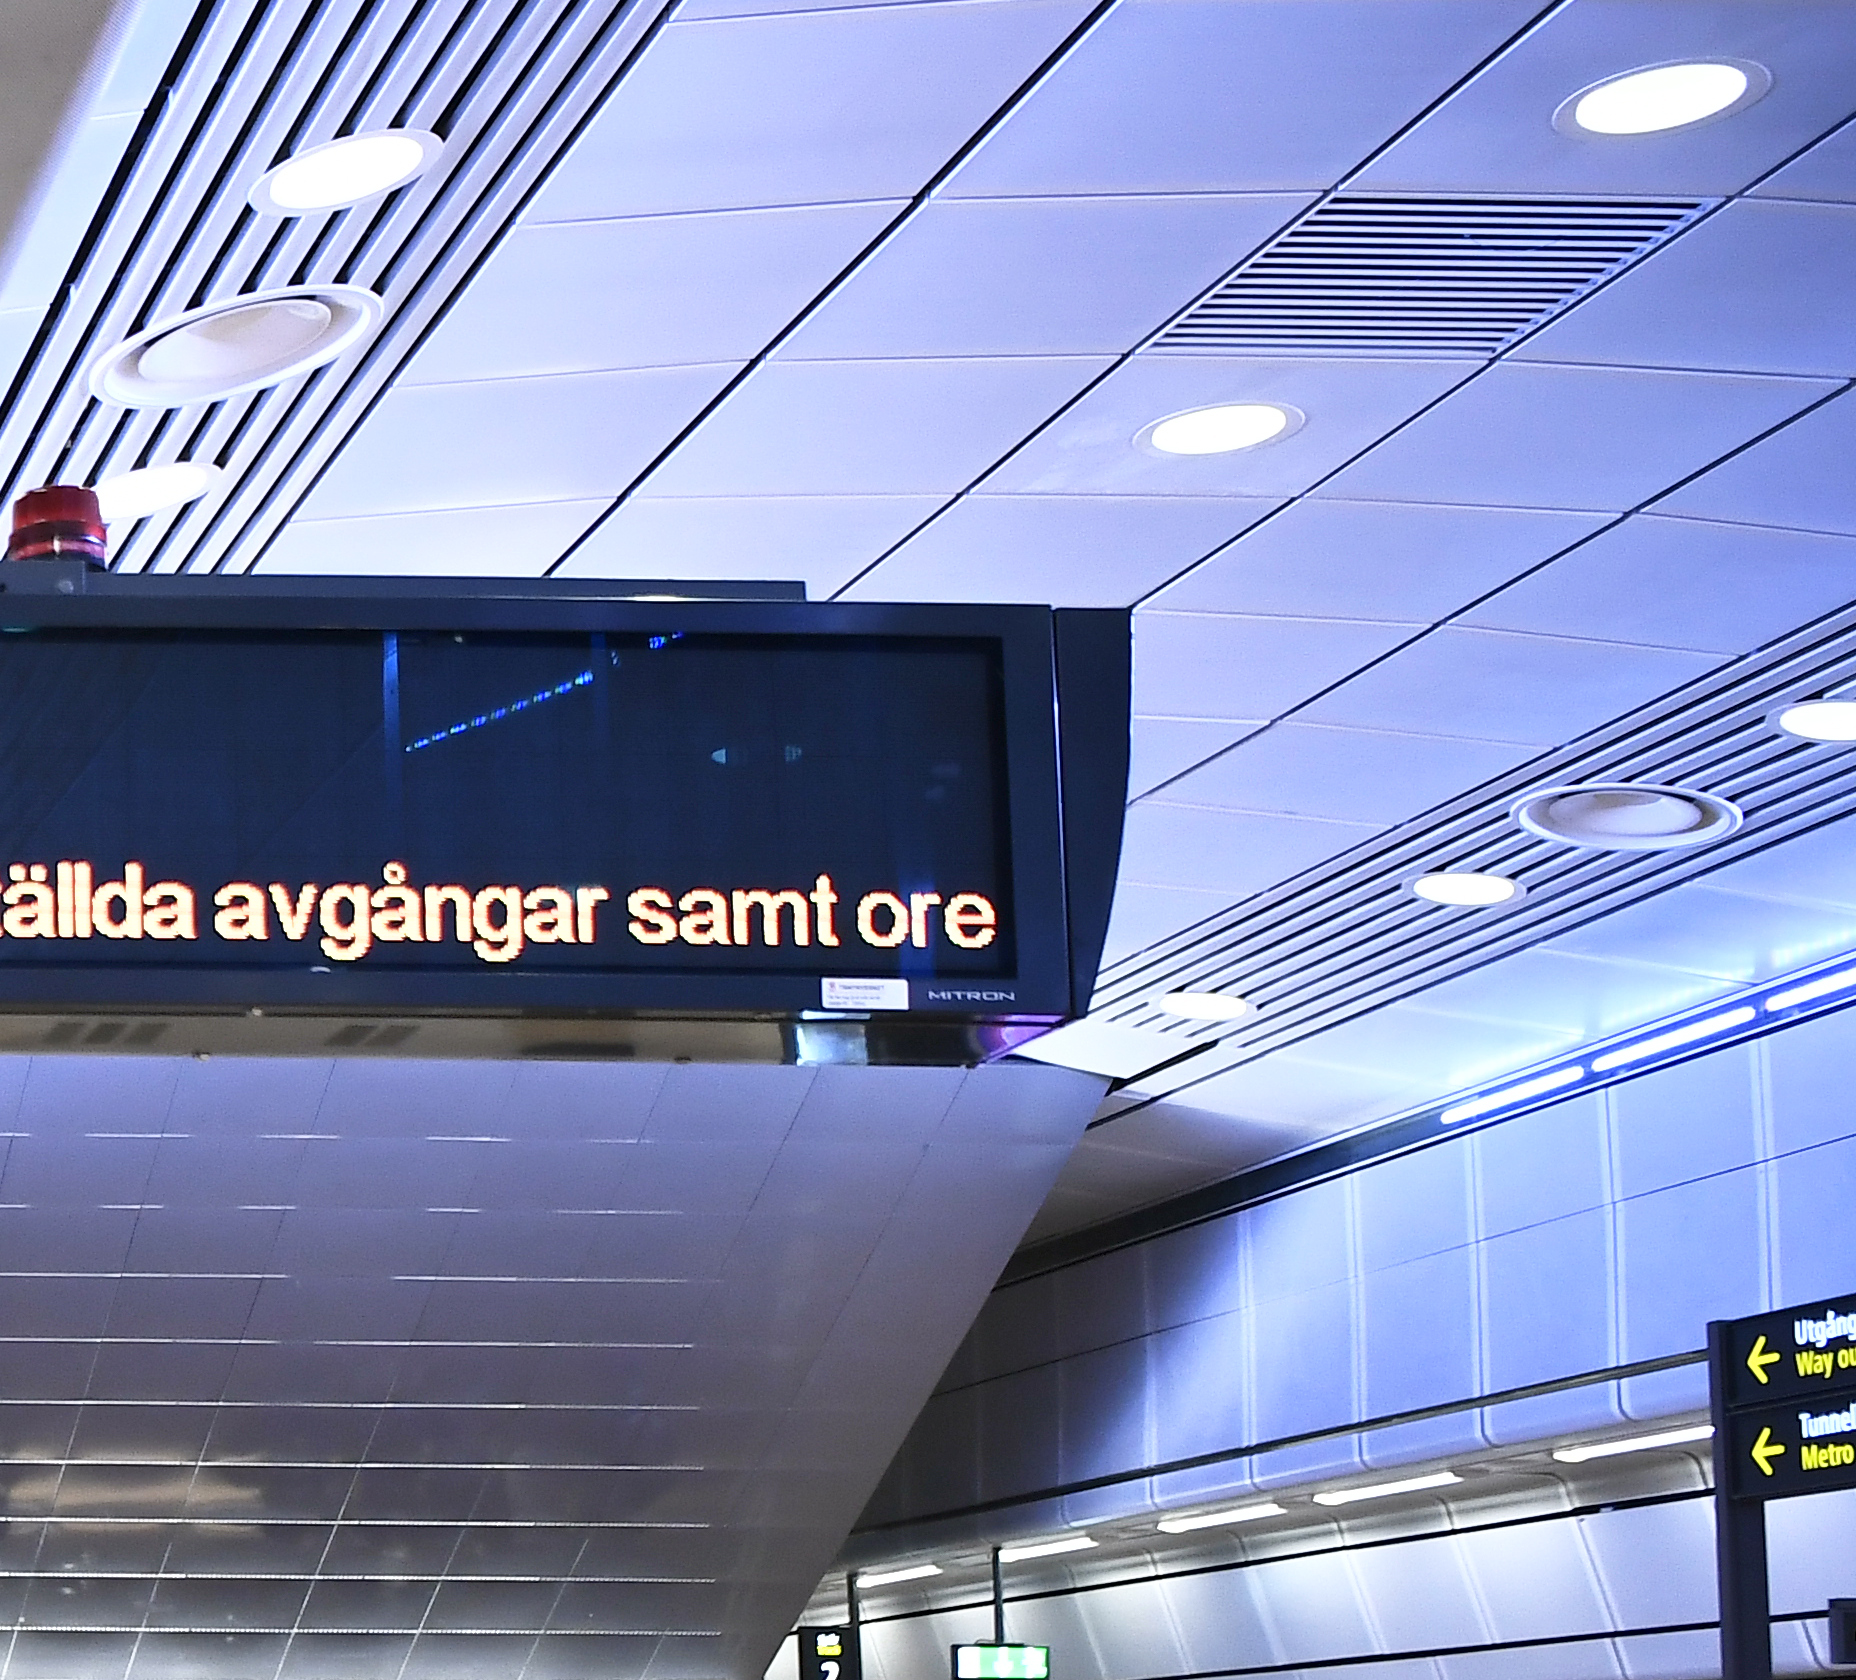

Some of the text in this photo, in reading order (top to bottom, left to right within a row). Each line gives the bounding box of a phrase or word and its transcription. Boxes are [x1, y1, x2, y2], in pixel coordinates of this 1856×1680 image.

[212, 860, 611, 963] avgångar
[626, 872, 841, 948] samt
[856, 890, 998, 950] ore
[928, 990, 1016, 1002] MITRON
[1795, 1351, 1834, 1379] Way
[1801, 1443, 1855, 1470] Metro
